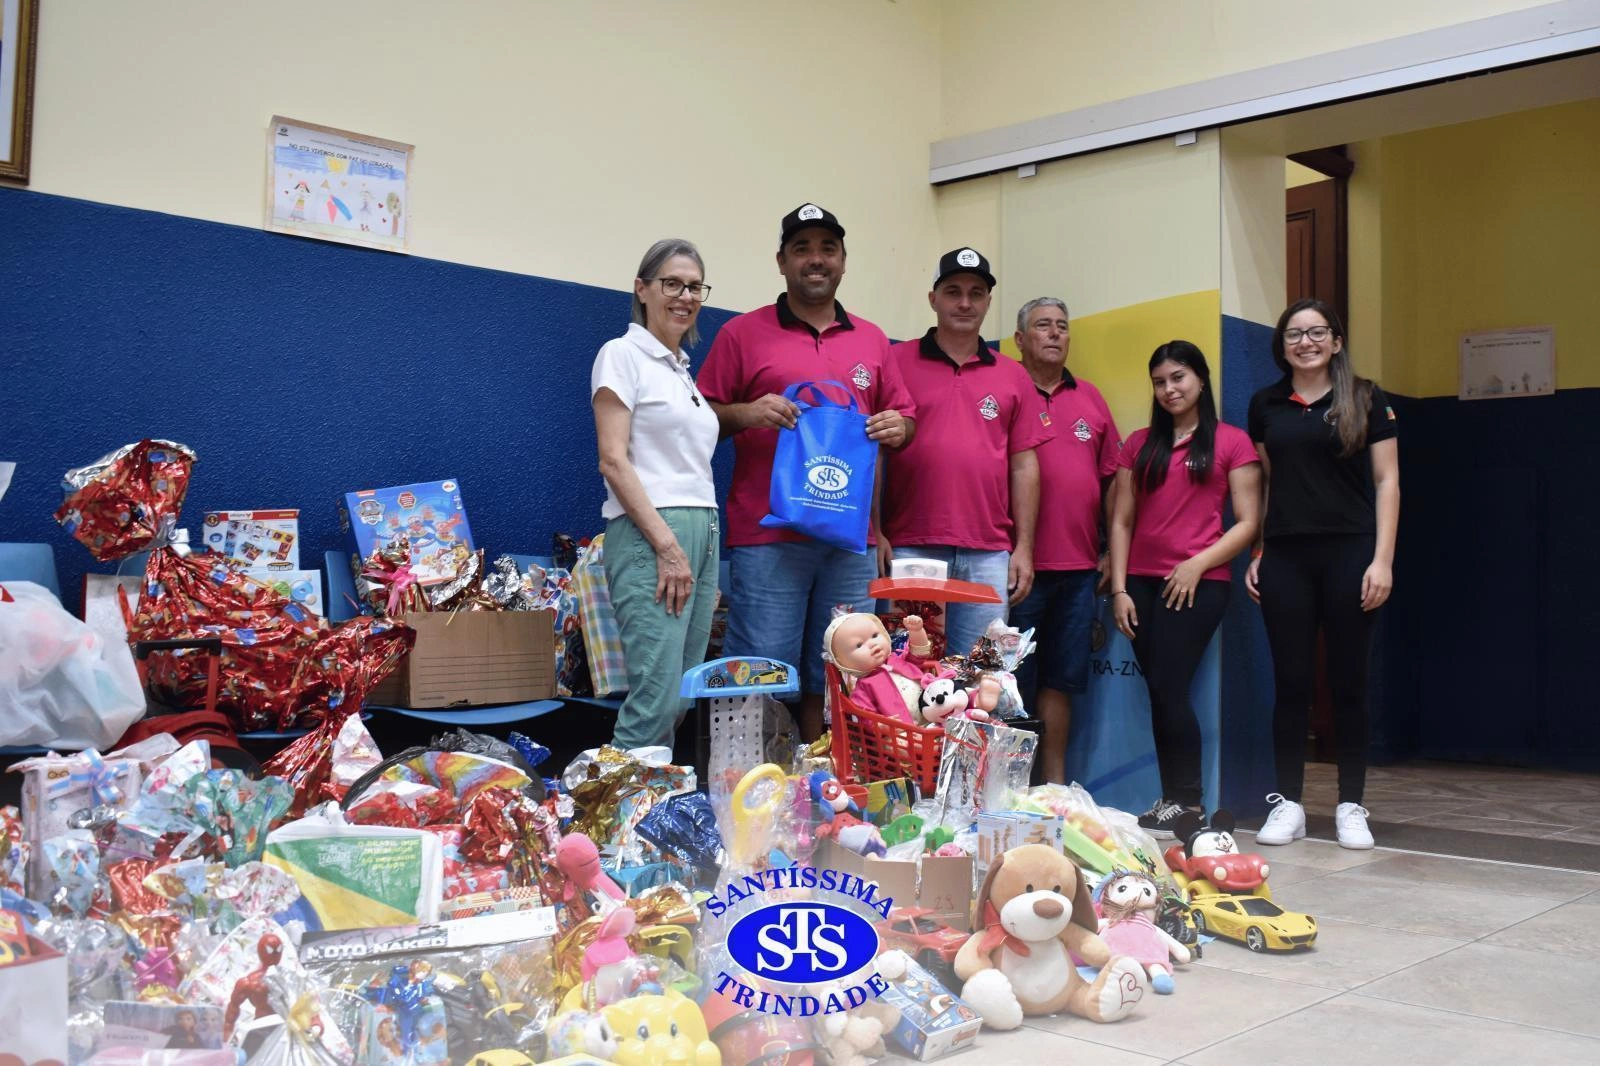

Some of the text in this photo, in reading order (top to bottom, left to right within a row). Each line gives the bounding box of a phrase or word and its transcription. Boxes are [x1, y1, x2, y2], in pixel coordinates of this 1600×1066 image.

[804, 455, 853, 476] SANTÍSSIMA
[816, 467, 840, 487] STS
[803, 482, 849, 500] TRINDADE
[1091, 660, 1145, 676] RA-ZN
[306, 937, 446, 959] MOTO NAKED
